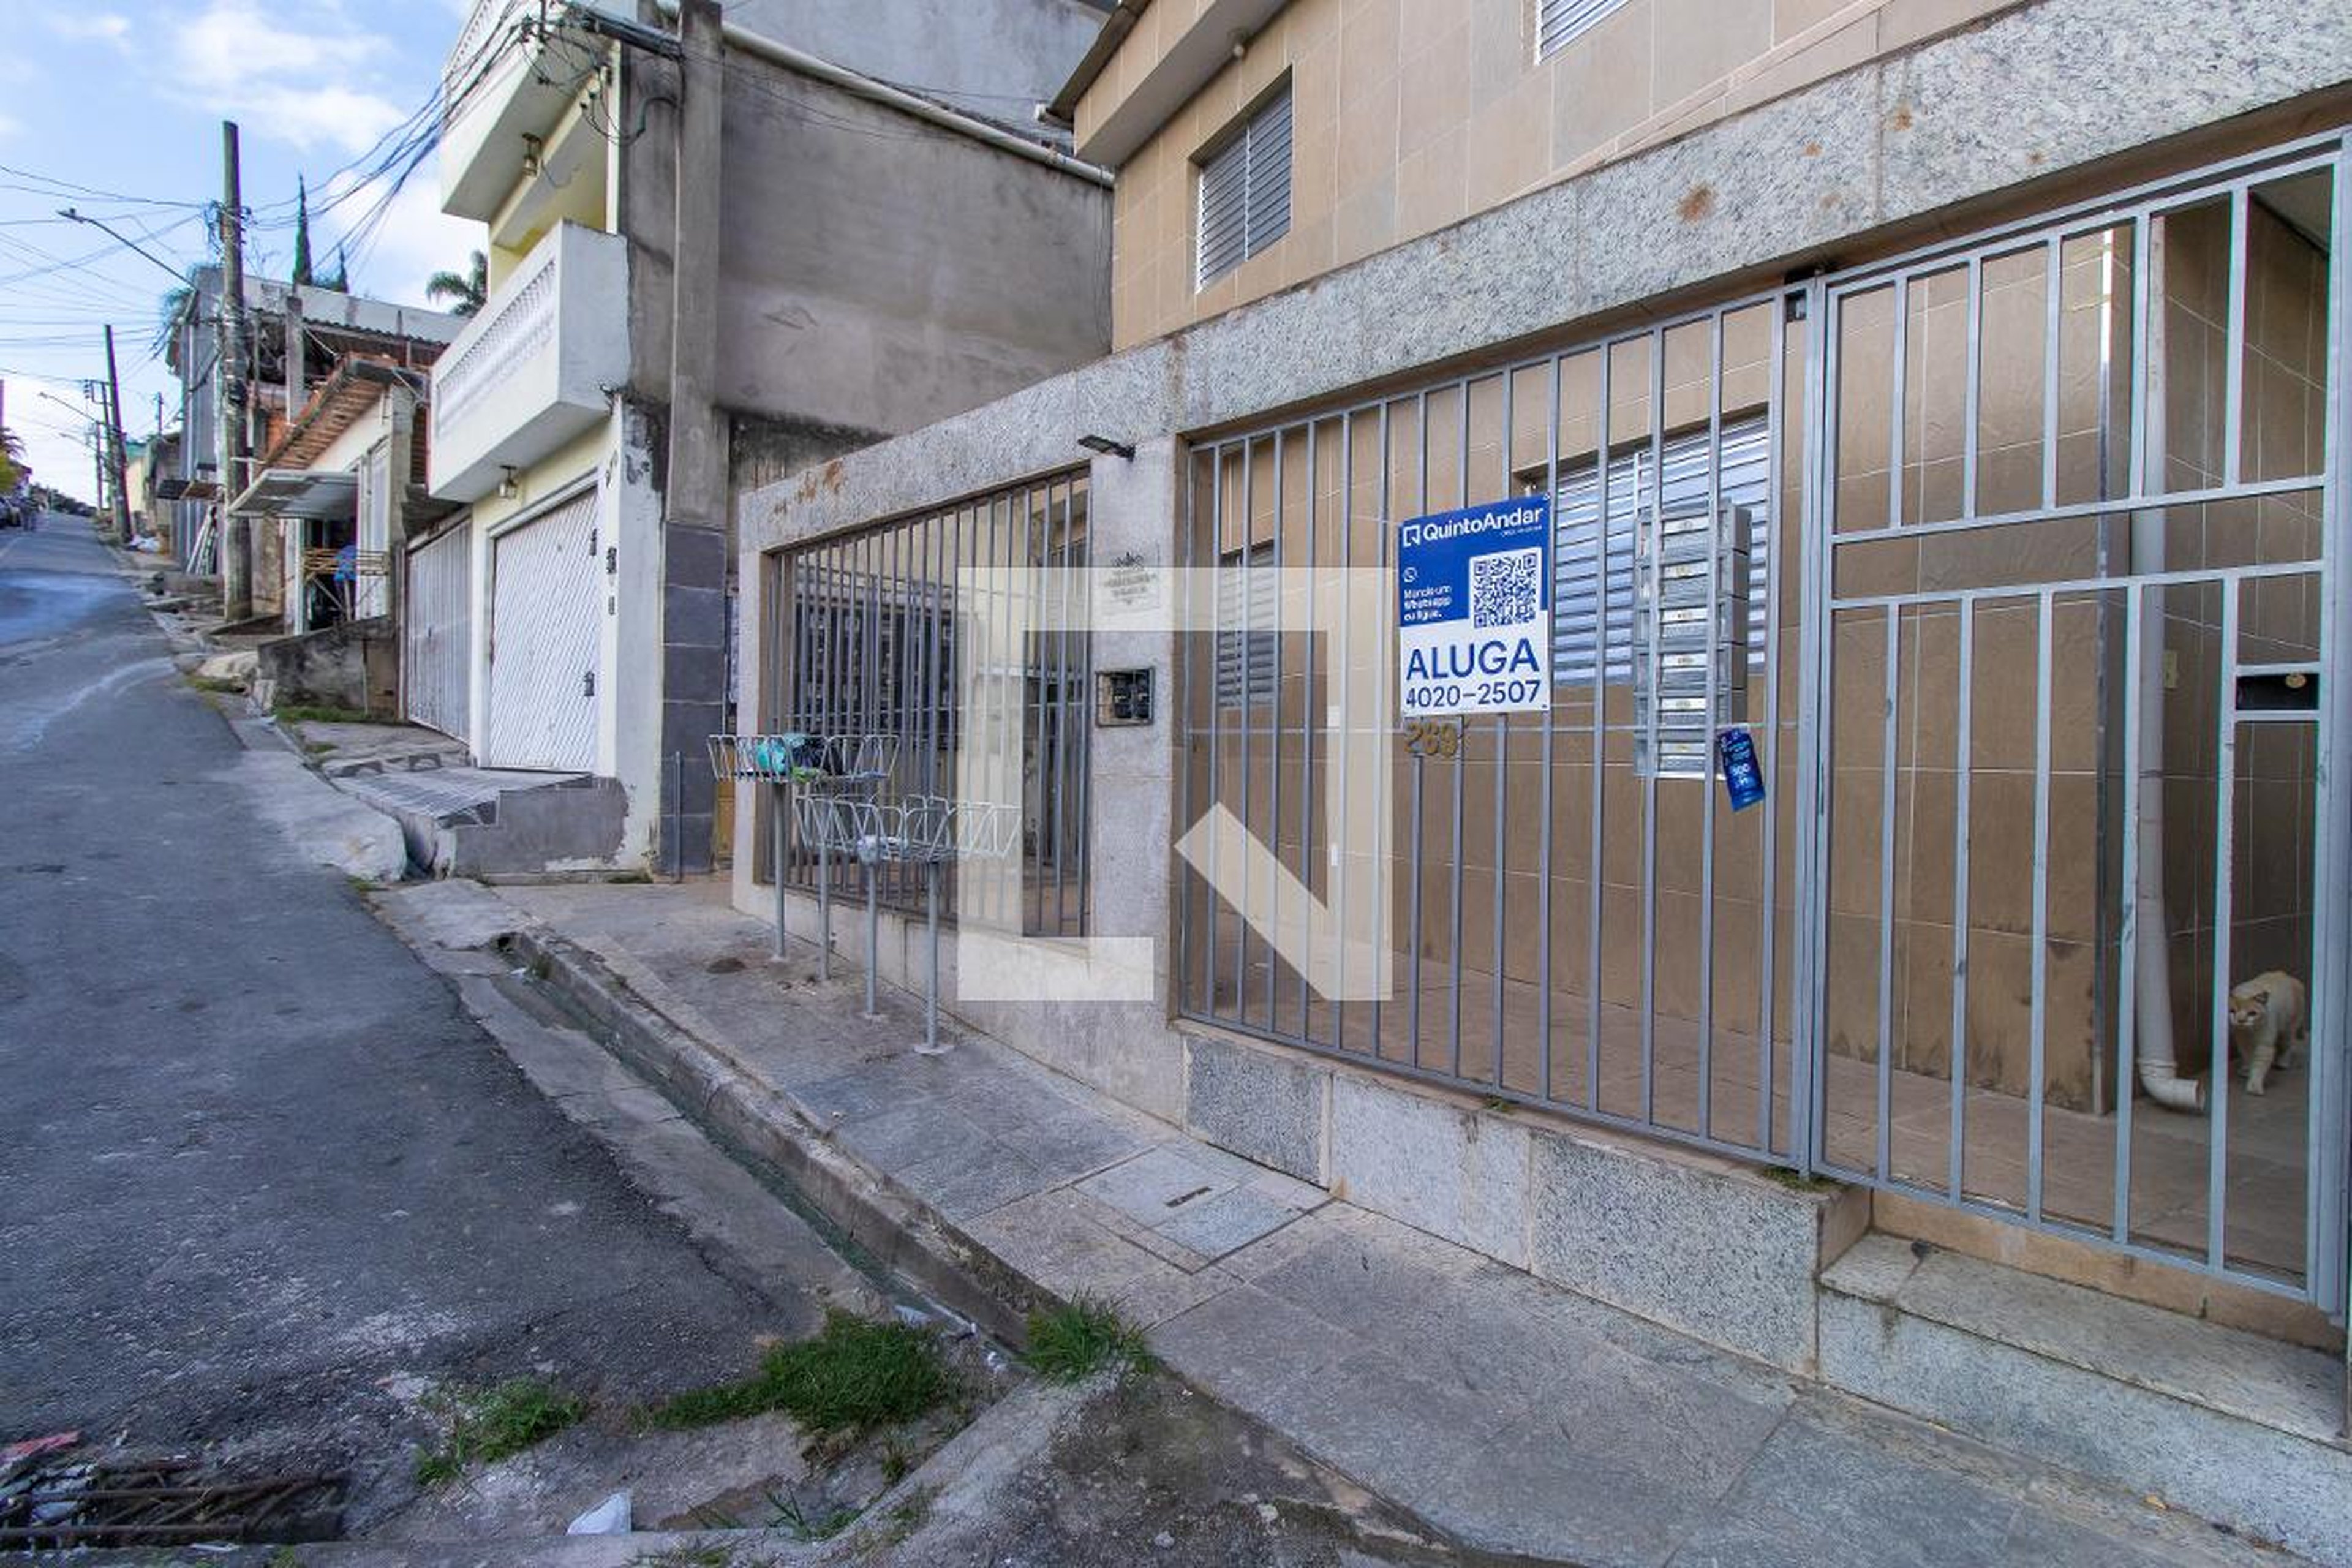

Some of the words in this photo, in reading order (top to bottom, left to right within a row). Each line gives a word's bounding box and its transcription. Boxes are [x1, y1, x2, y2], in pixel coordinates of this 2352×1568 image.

[1423, 507, 1544, 541] QuintoAndar
[1406, 637, 1540, 681] ALUGA
[1406, 680, 1541, 708] 4020-2507
